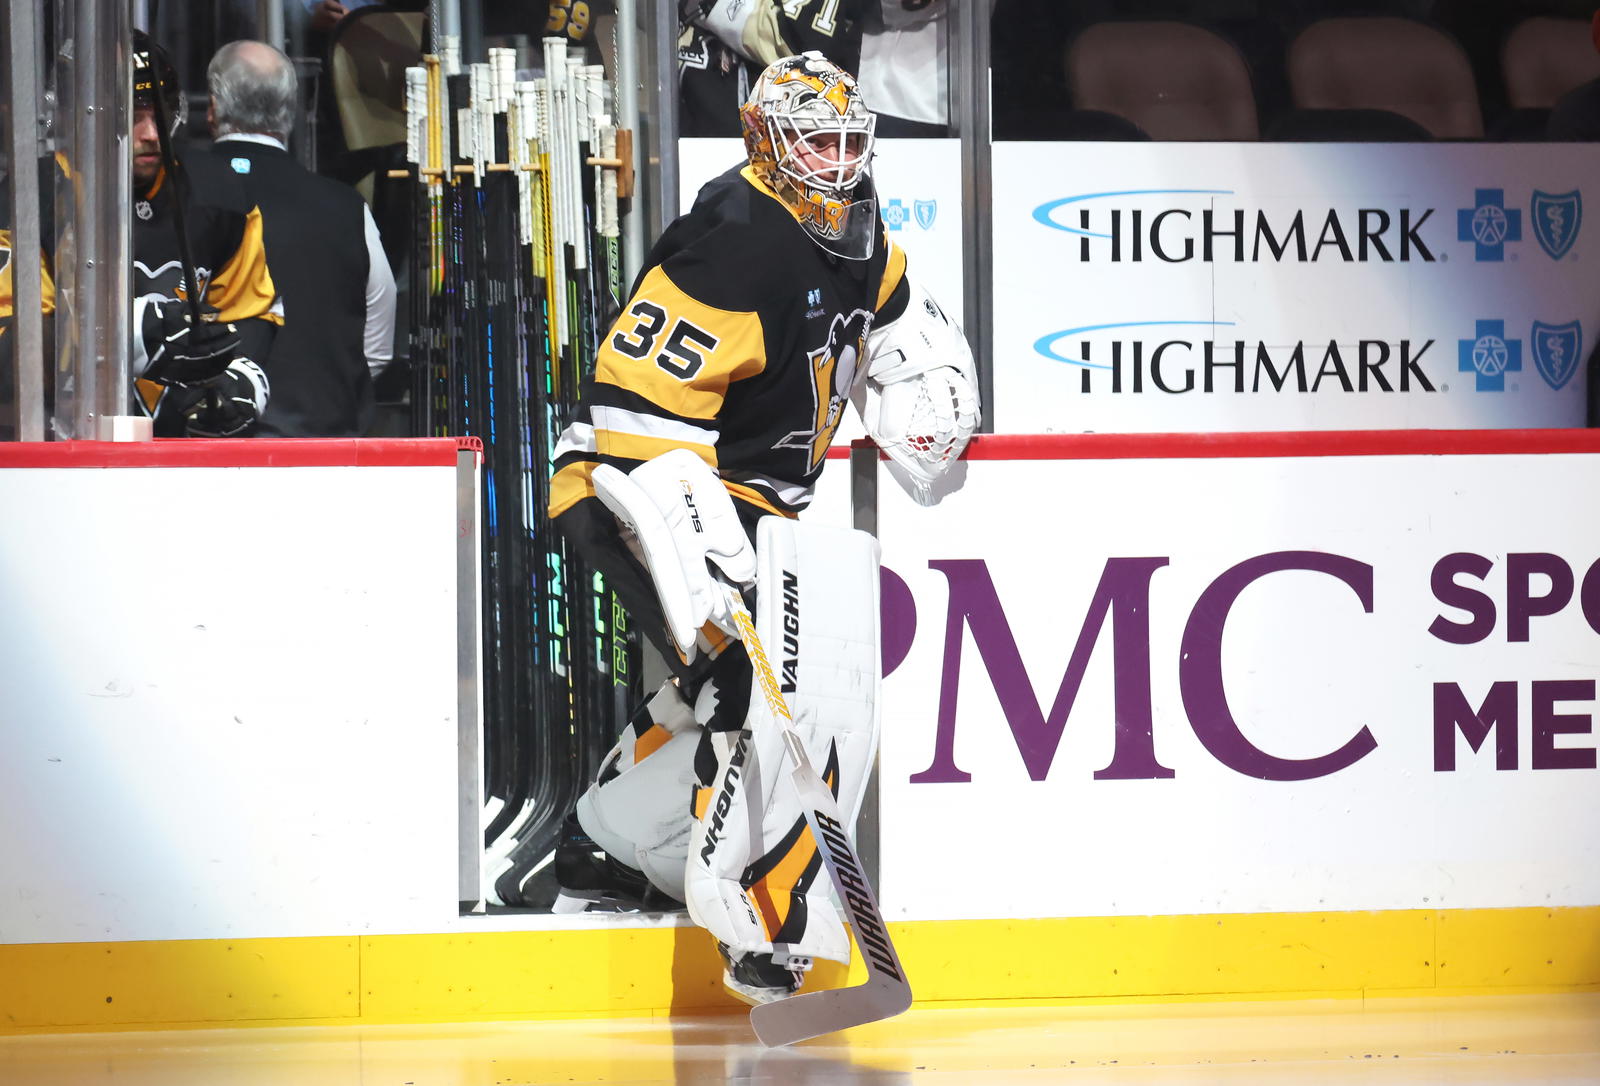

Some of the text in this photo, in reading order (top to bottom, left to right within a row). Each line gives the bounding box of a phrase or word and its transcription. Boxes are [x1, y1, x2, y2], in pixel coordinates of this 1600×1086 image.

[1080, 208, 1437, 262] HIGHMARK
[611, 299, 720, 381] 35
[1080, 339, 1437, 393] HIGHMARK
[781, 569, 799, 692] VAUGHN
[1428, 552, 1600, 645] SP
[1433, 679, 1598, 772] ME
[700, 729, 753, 867] VAUGHN
[814, 809, 903, 983] WARRIOR
